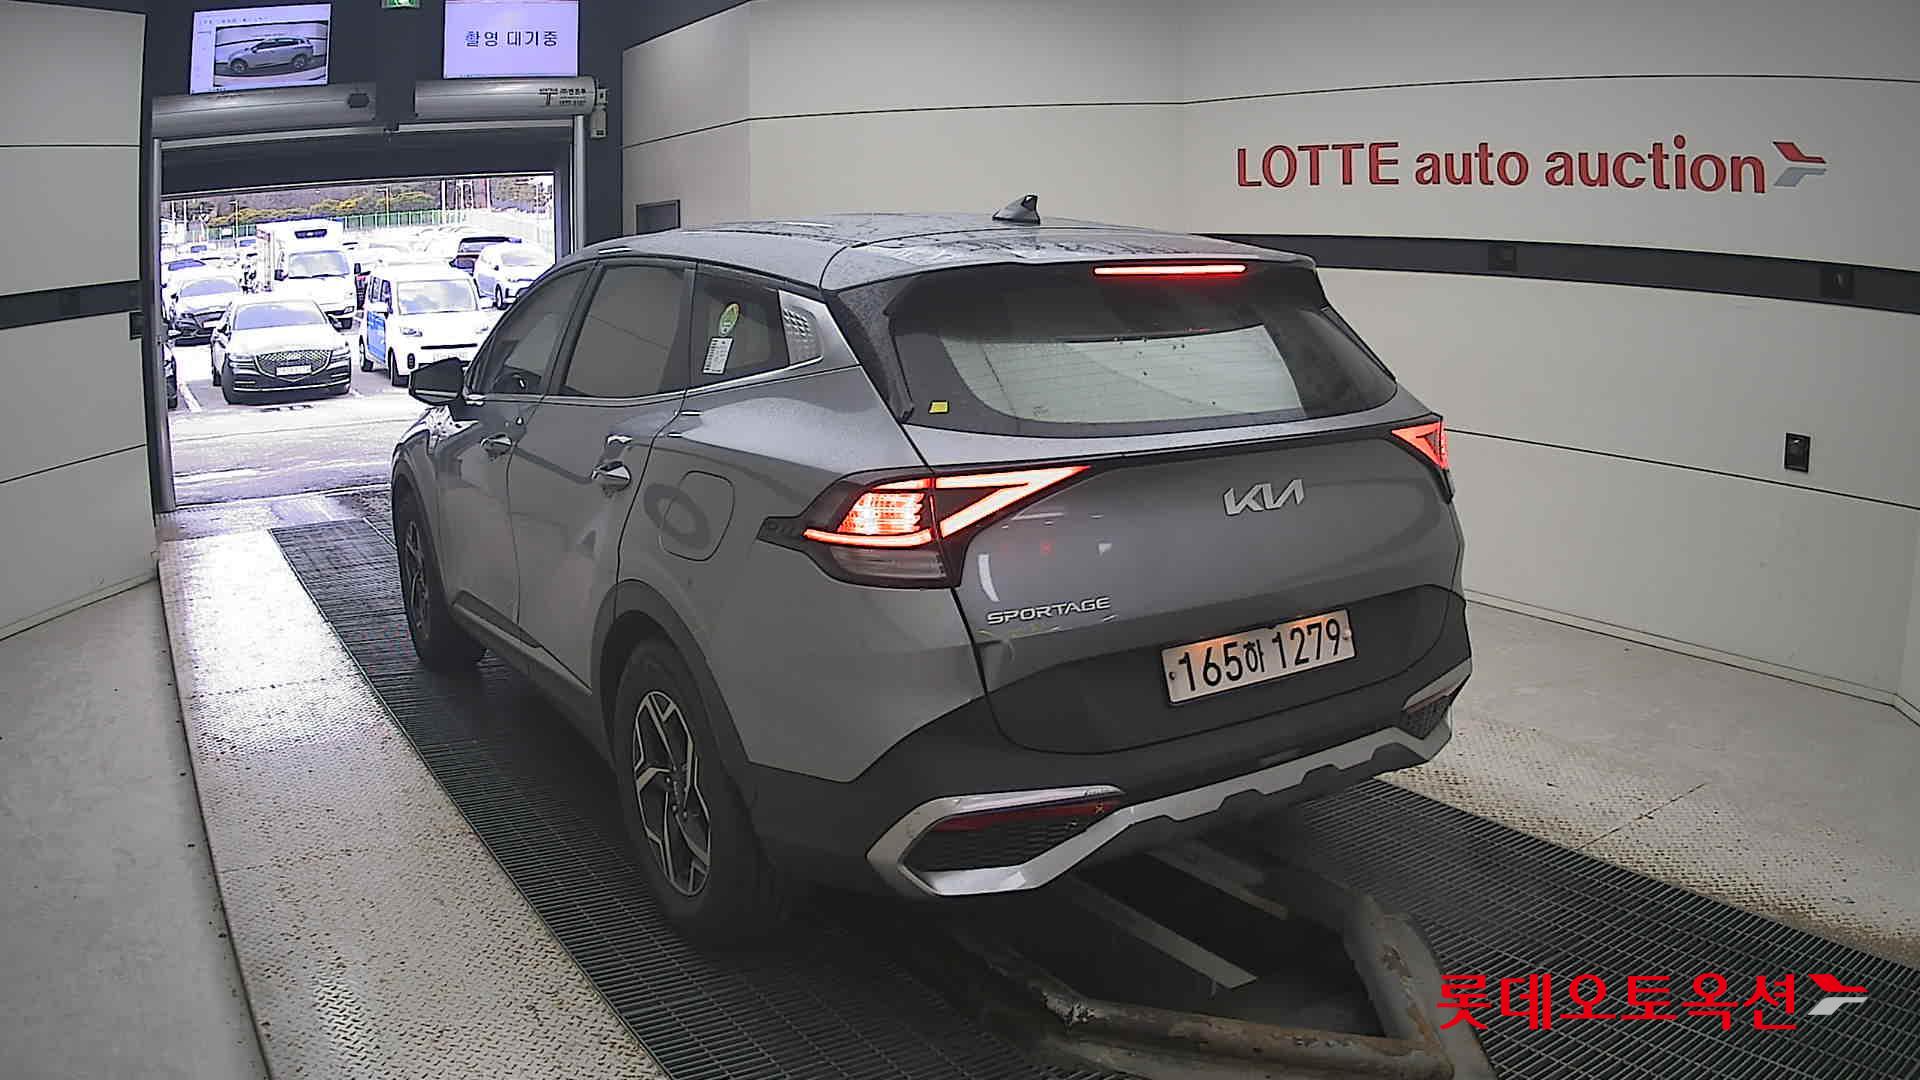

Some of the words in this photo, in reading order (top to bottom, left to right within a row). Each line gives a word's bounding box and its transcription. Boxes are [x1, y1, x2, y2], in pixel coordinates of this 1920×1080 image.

[506, 30, 558, 47] 대기중
[1236, 141, 1399, 188] LOTTE
[1415, 142, 1529, 187] auto
[1545, 134, 1766, 194] auction
[1223, 478, 1305, 516] KIA
[986, 596, 1112, 626] SPORTAGE
[1178, 640, 1266, 692] 165하
[1271, 617, 1341, 670] 1279
